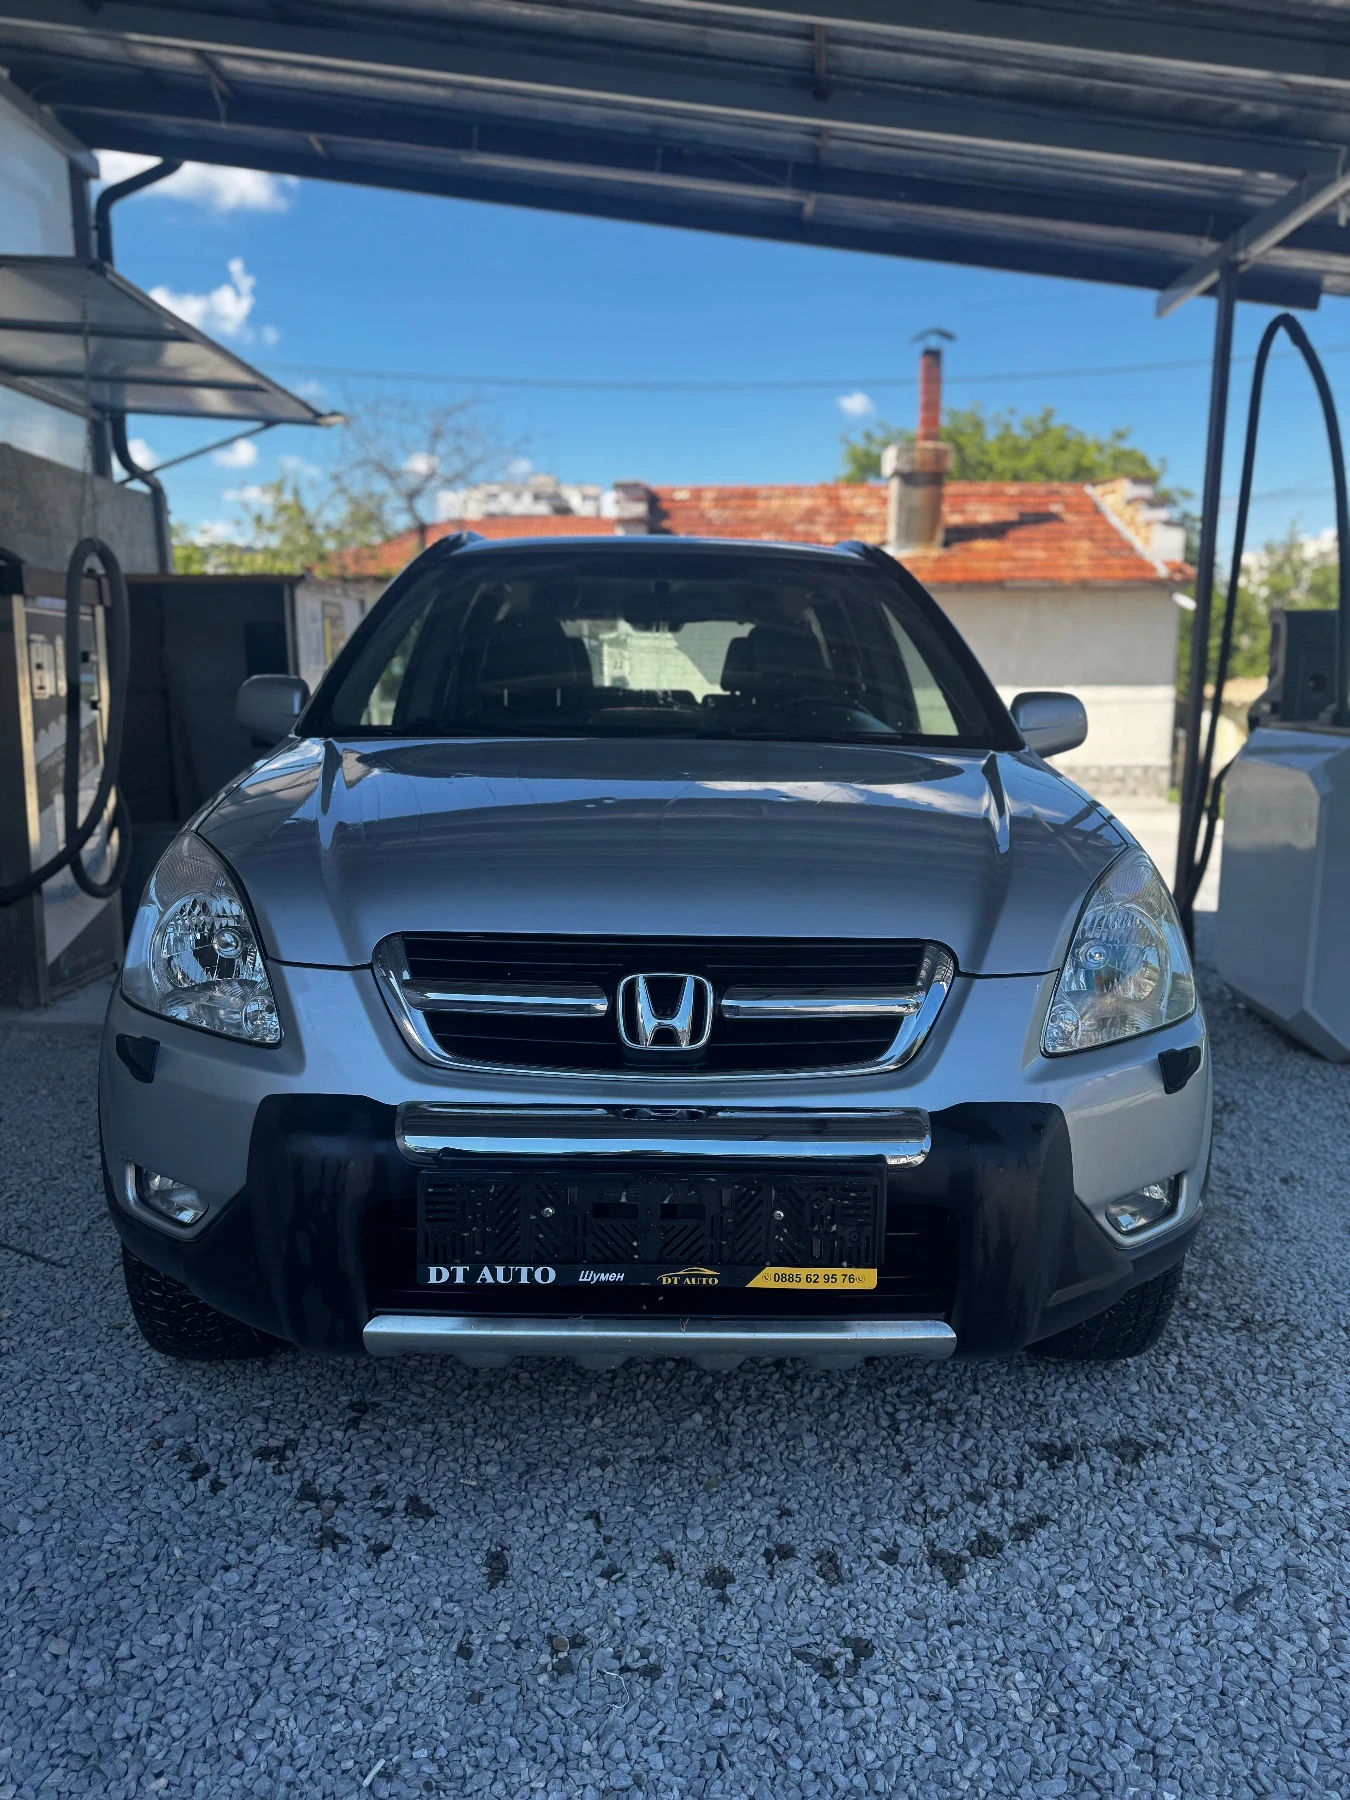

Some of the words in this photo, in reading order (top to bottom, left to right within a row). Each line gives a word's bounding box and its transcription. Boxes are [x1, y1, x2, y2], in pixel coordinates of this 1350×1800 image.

[427, 1266, 470, 1284] DT
[476, 1266, 556, 1284] AUTO
[579, 1270, 625, 1284] Шумен
[661, 1276, 680, 1285] DT
[682, 1276, 719, 1286] AUTO
[773, 1272, 802, 1283] 0885
[805, 1273, 820, 1284] 62
[823, 1273, 838, 1284] 95
[841, 1273, 856, 1284] 76
